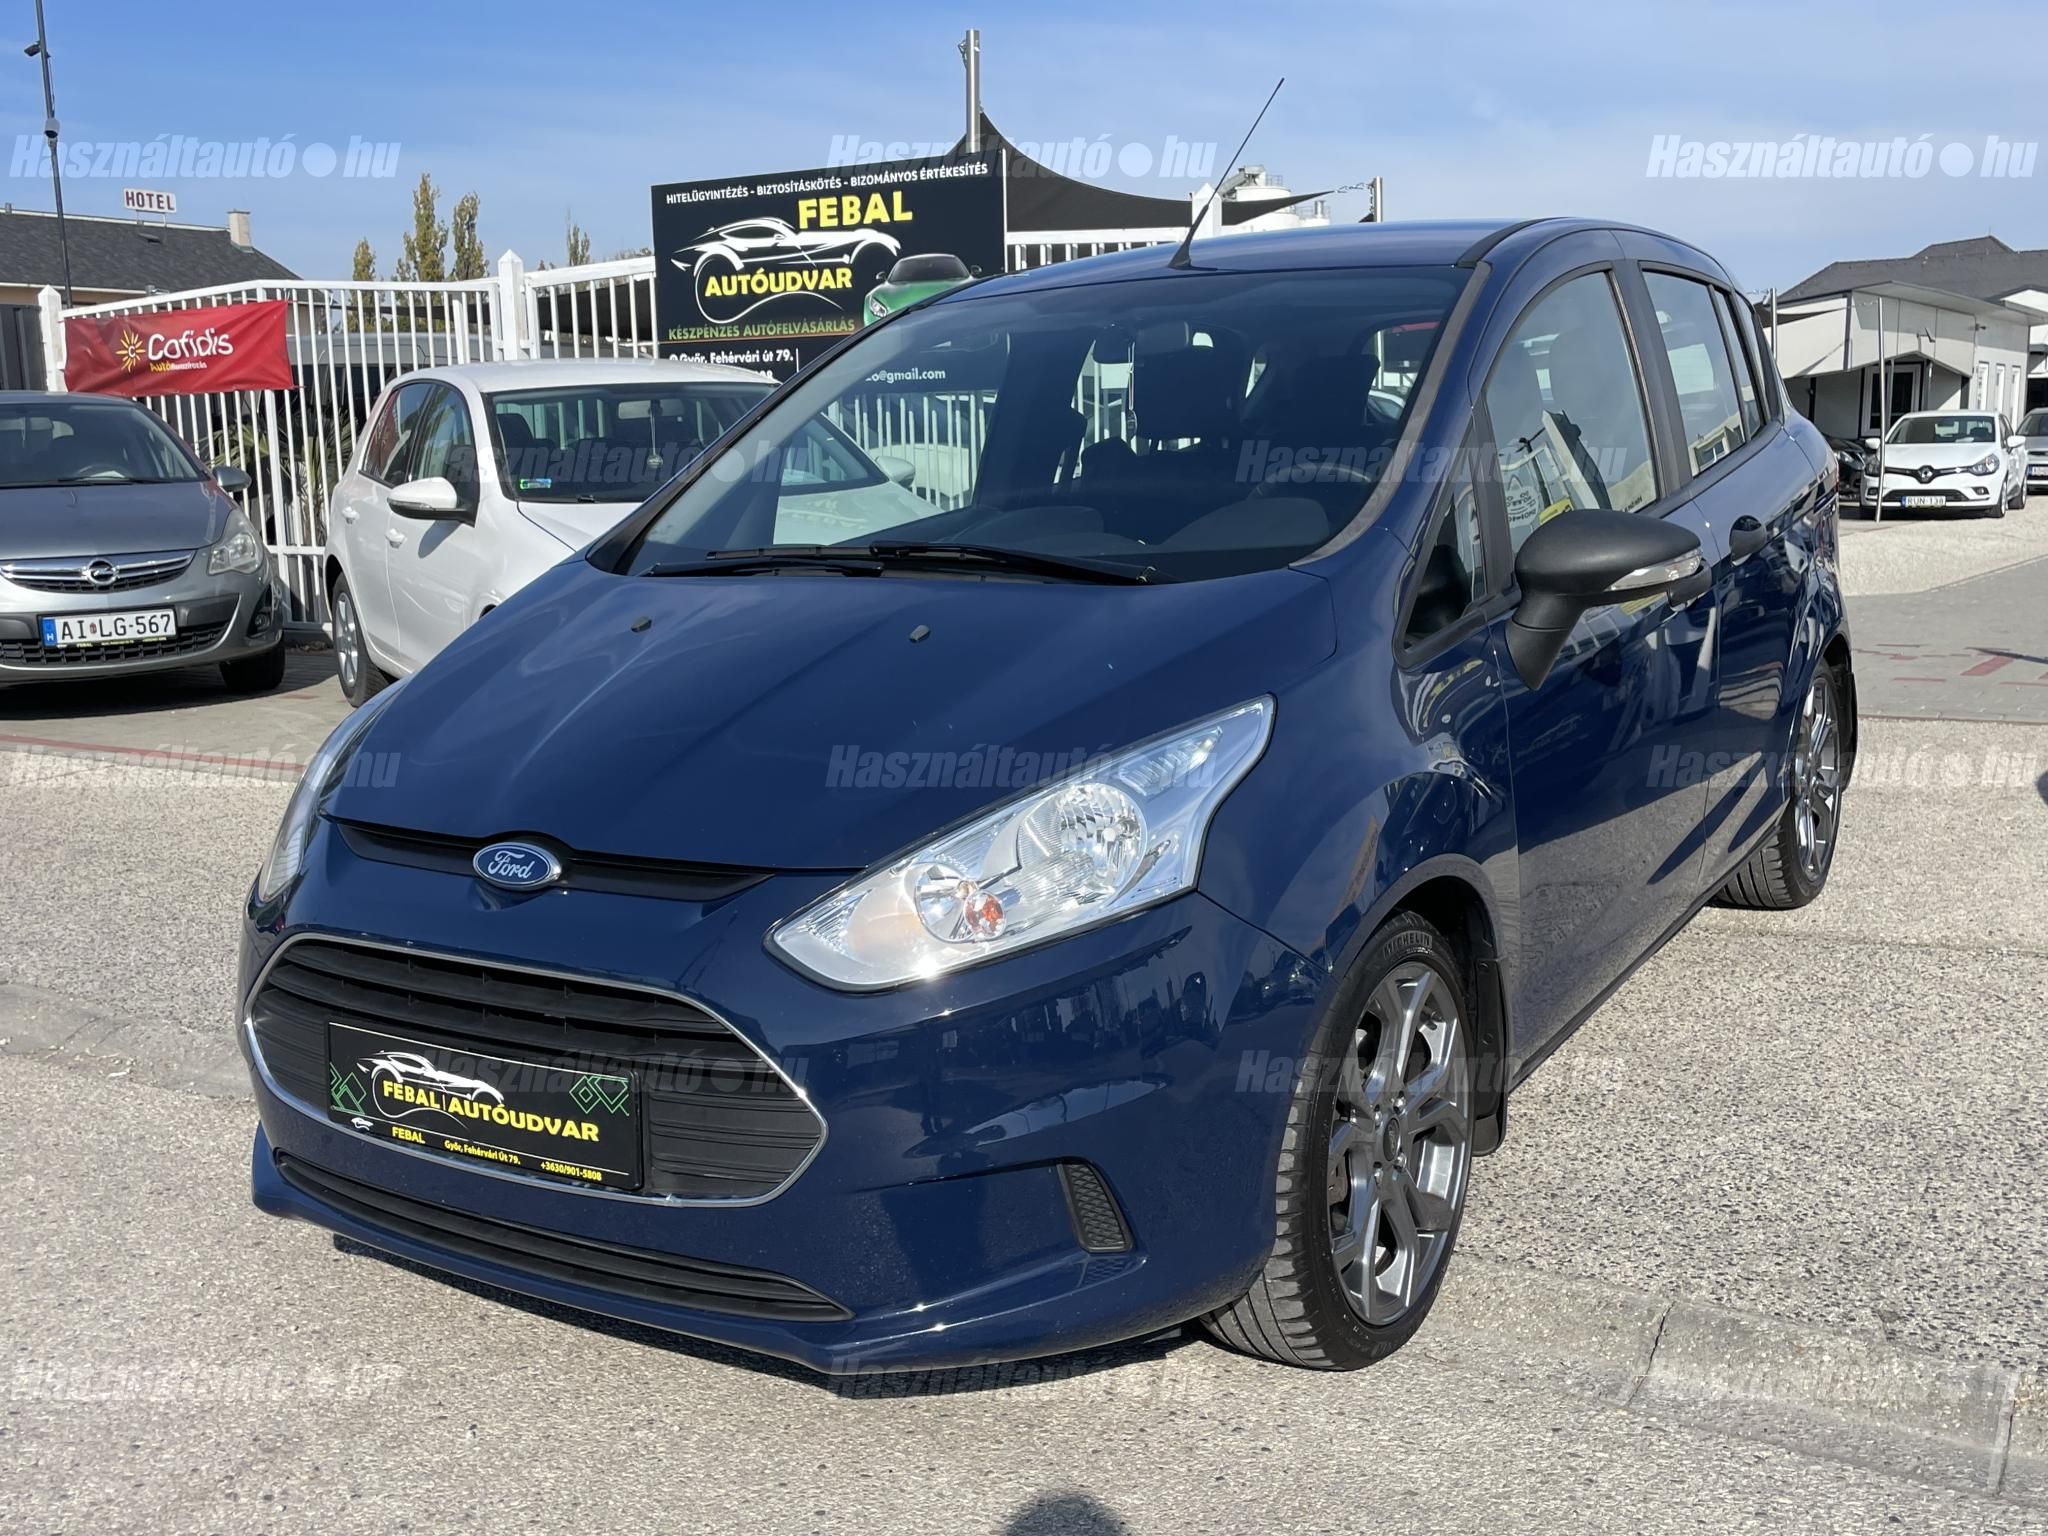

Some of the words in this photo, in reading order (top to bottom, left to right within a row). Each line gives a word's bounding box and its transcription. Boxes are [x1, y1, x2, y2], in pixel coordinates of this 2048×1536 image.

[666, 185, 748, 204] HITELÜGYINTÉZÉS
[757, 176, 842, 196] BIZTOSÍTÁSKÖTÉS
[851, 170, 918, 187] BIZOMÁNYOS
[920, 161, 988, 180] ÉRTÉKESÍTÉS
[125, 191, 175, 211] HOTEL
[798, 190, 913, 229] FEBAL
[705, 267, 853, 297] AUTÓUDVAR
[668, 323, 740, 341] KÉSZPÉNZES
[743, 316, 855, 337] AUTÓFELVÁSÁRLÁS
[148, 328, 234, 361] Cofidis
[710, 349, 760, 364] Fehérvári
[762, 349, 774, 362] út
[776, 348, 794, 362] 79.
[61, 619, 87, 641] AI
[99, 614, 171, 637] LG-567
[487, 850, 536, 879] Ford
[382, 1080, 441, 1110] FEBAL
[448, 1096, 600, 1142] AUTÓUDVAR
[391, 1126, 426, 1145] FEBAL
